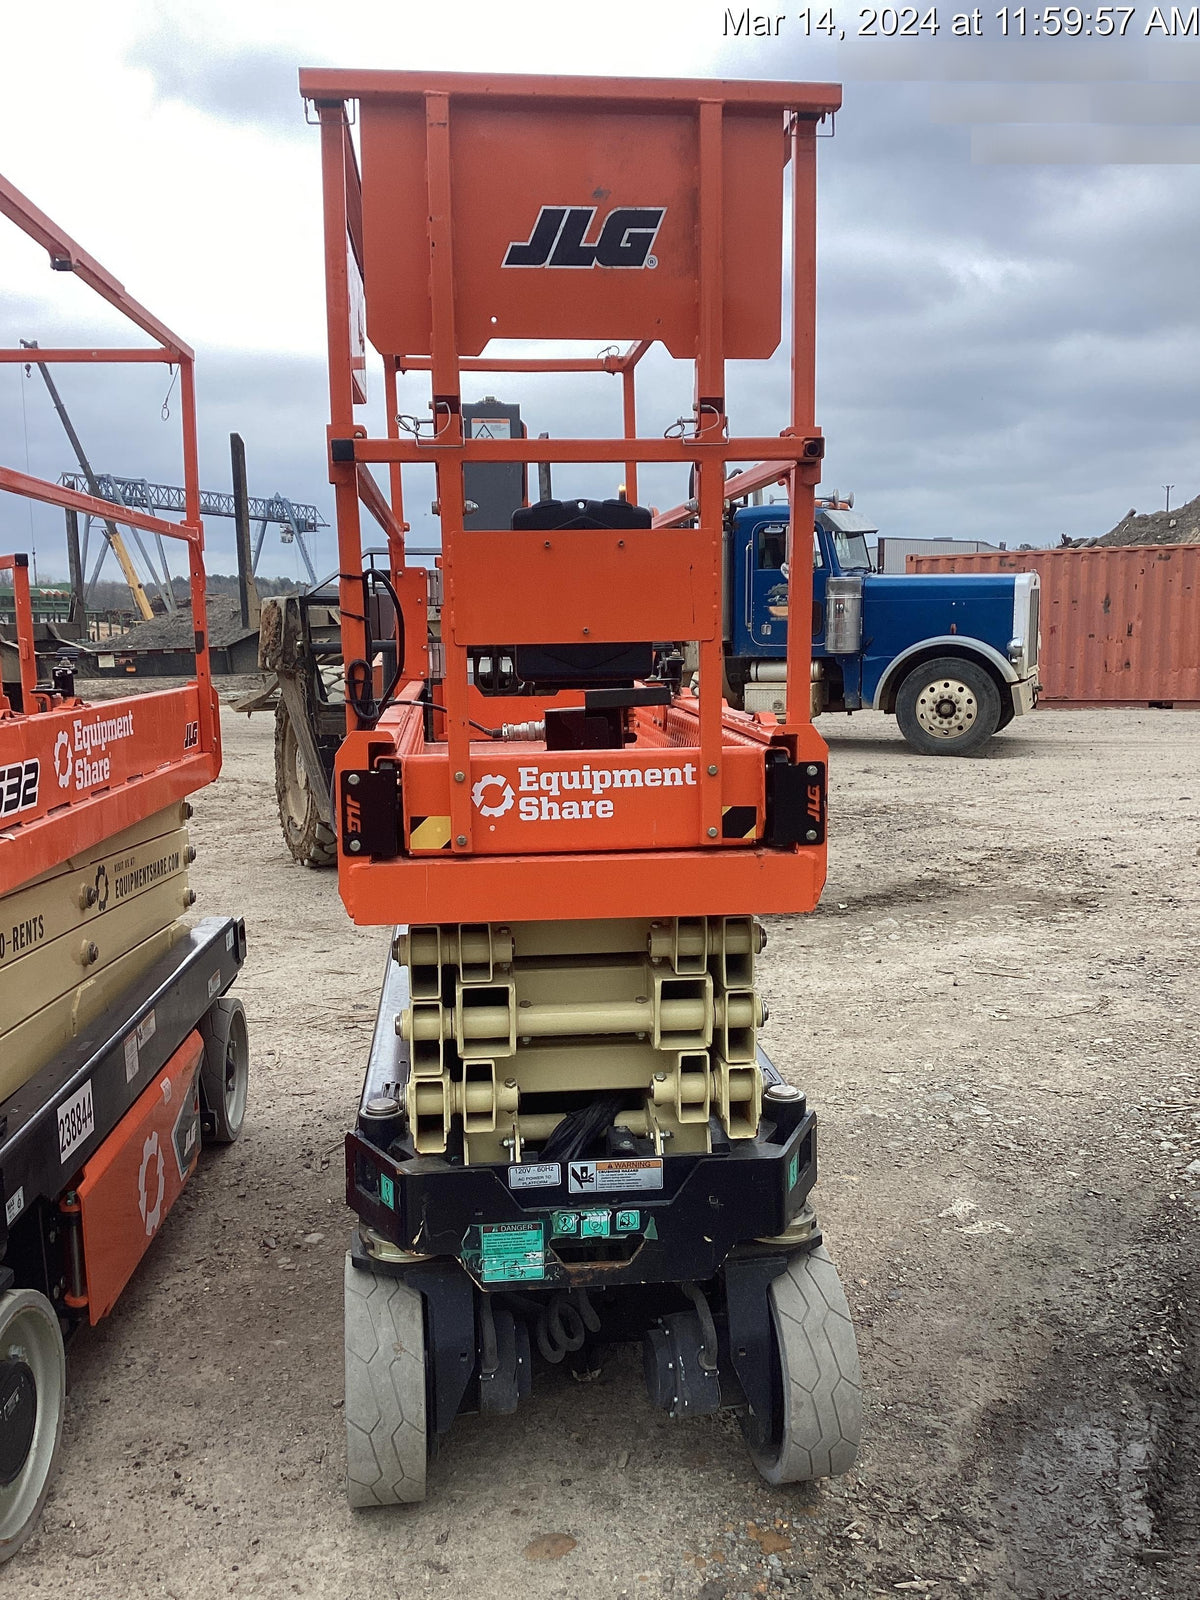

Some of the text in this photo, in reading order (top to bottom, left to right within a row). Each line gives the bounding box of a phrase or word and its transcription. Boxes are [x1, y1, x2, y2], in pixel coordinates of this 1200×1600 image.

[501, 205, 668, 269] JLG
[73, 710, 134, 756] Equipment
[184, 720, 199, 750] JLG
[0, 757, 40, 818] 32
[74, 755, 110, 790] Share
[518, 763, 697, 796] Equipment
[346, 793, 362, 833] JLG
[518, 797, 614, 821] Share
[807, 784, 821, 823] JLG
[115, 852, 179, 899] EQUIPMENTSHARE.COM
[59, 1091, 93, 1153] 238844
[615, 1161, 651, 1169] WARNING
[500, 1224, 533, 1232] DANGER
